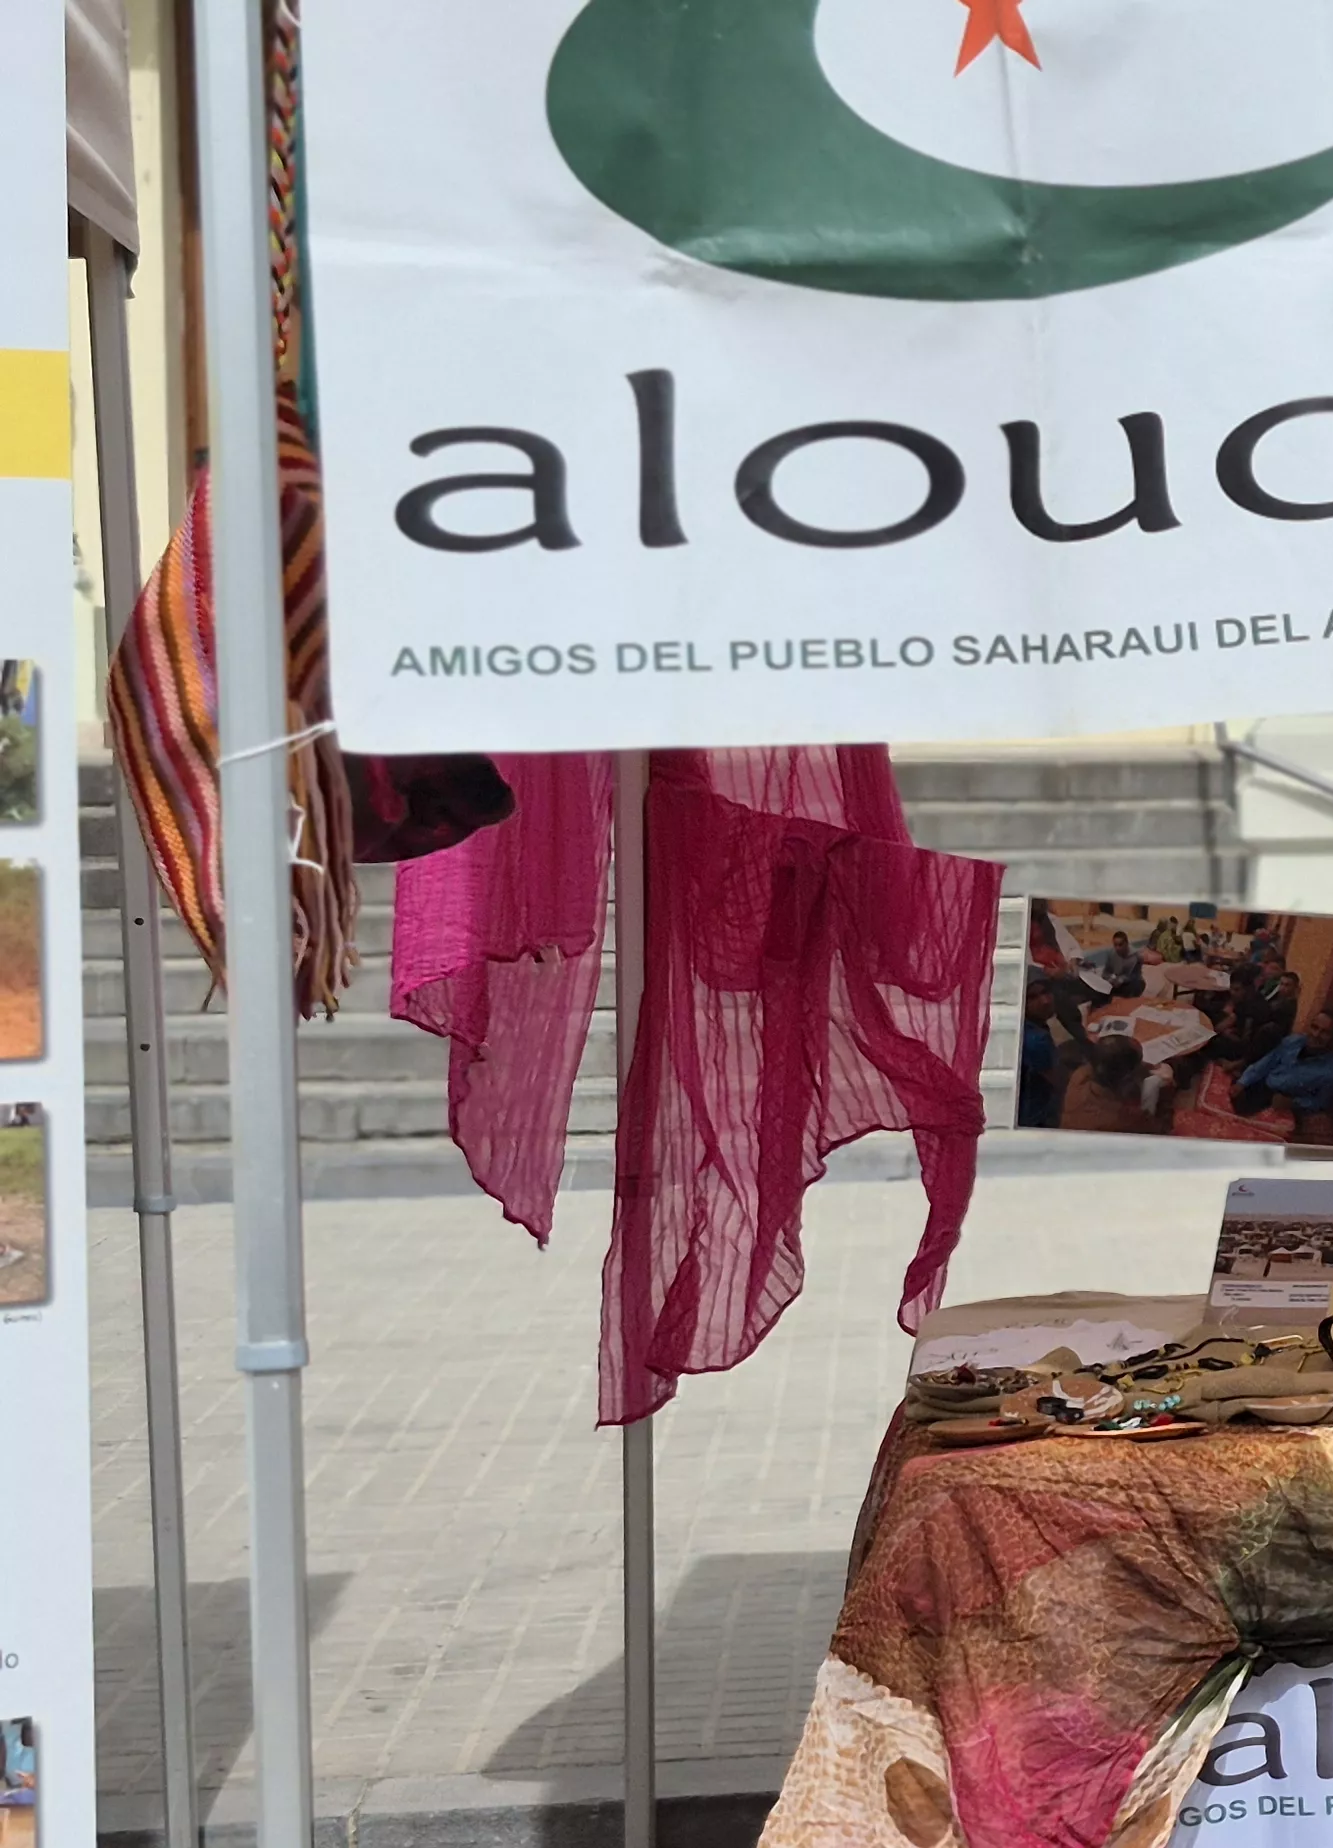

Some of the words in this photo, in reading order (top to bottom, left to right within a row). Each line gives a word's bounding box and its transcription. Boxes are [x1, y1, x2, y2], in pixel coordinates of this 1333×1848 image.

[392, 644, 597, 677] AMIGOS
[615, 641, 712, 673] DEL
[729, 636, 935, 670] PUEBLO
[952, 621, 1199, 666] SAHARAUI
[1214, 613, 1311, 649] DEL
[1178, 1799, 1248, 1828] GOS
[1257, 1795, 1316, 1817] DEL
